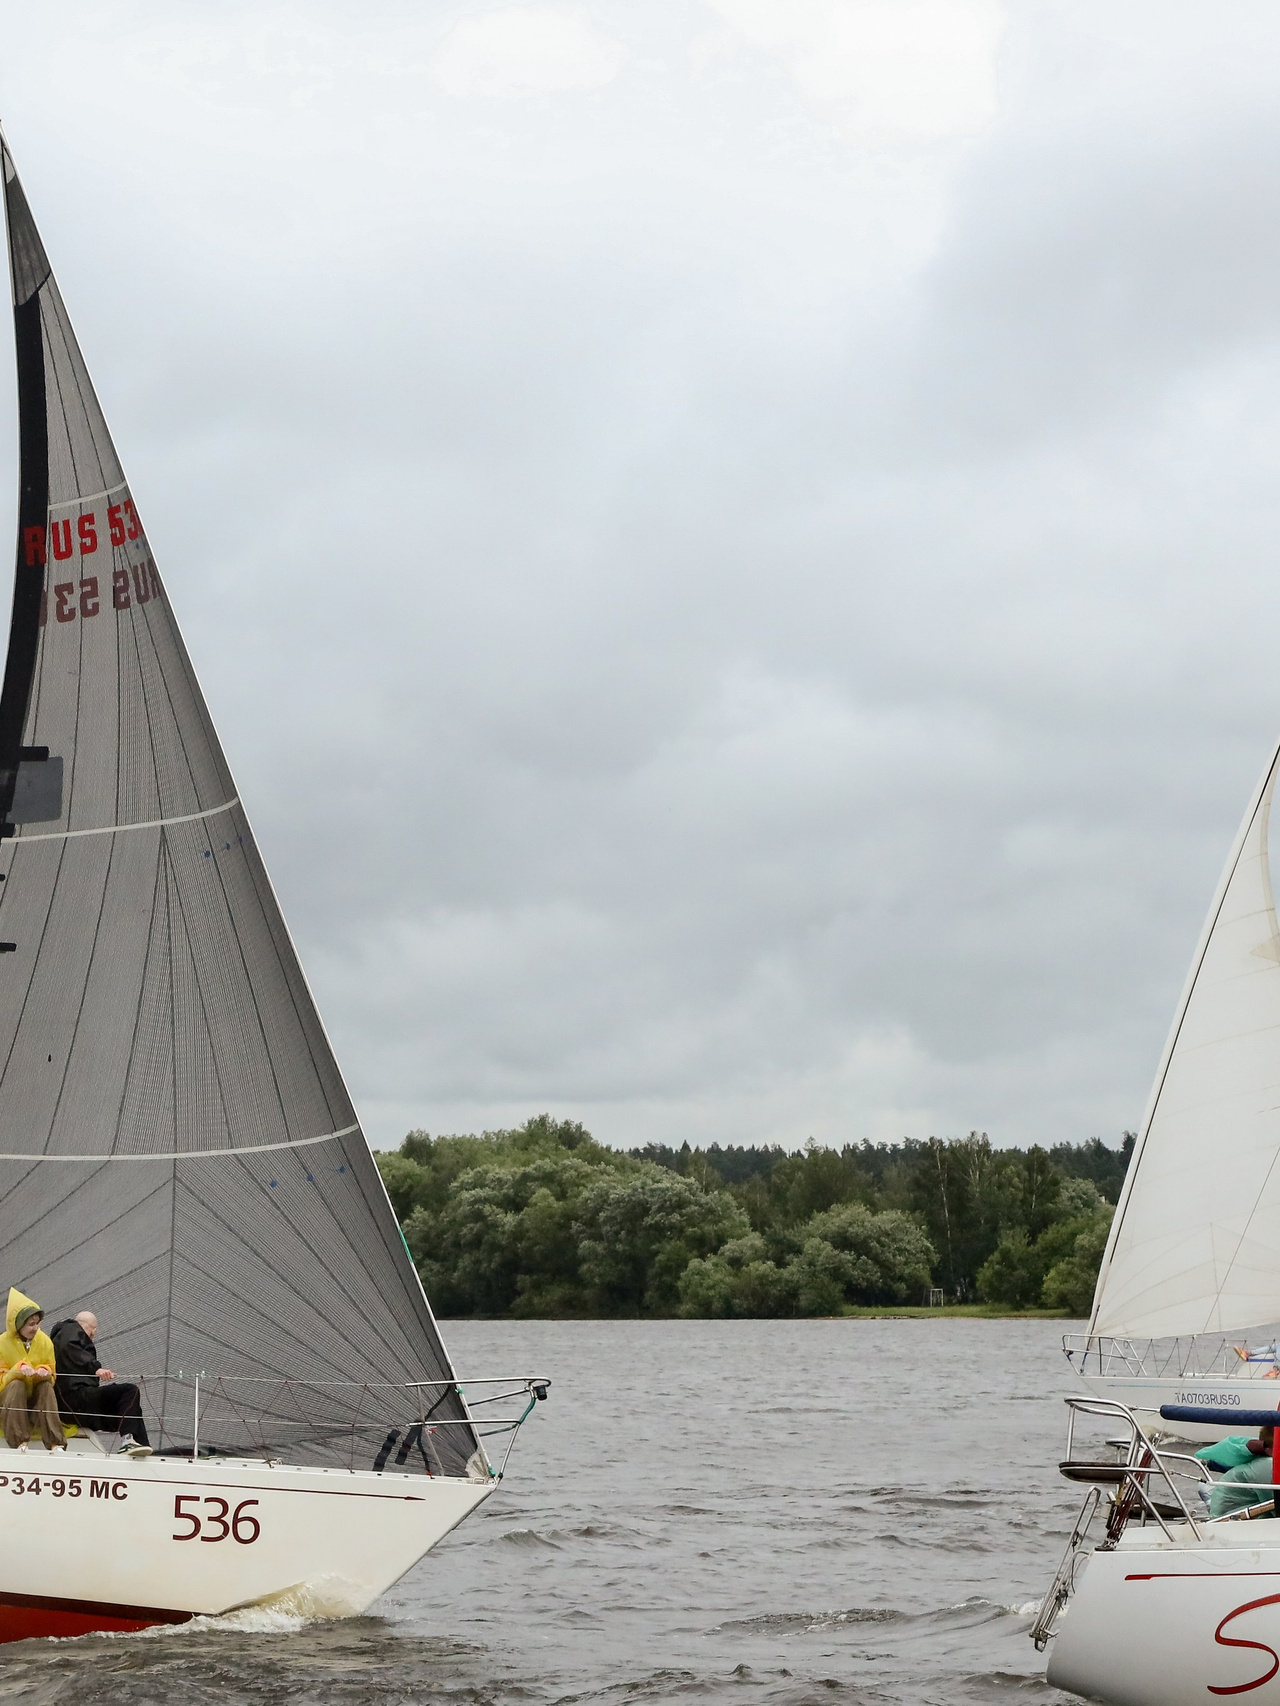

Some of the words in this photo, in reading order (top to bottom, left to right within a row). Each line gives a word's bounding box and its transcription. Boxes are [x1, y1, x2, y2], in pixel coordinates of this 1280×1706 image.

[24, 513, 98, 566] RUS
[107, 498, 145, 547] 53
[1175, 1393, 1240, 1406] TA0703RUS50
[172, 1495, 261, 1544] 536
